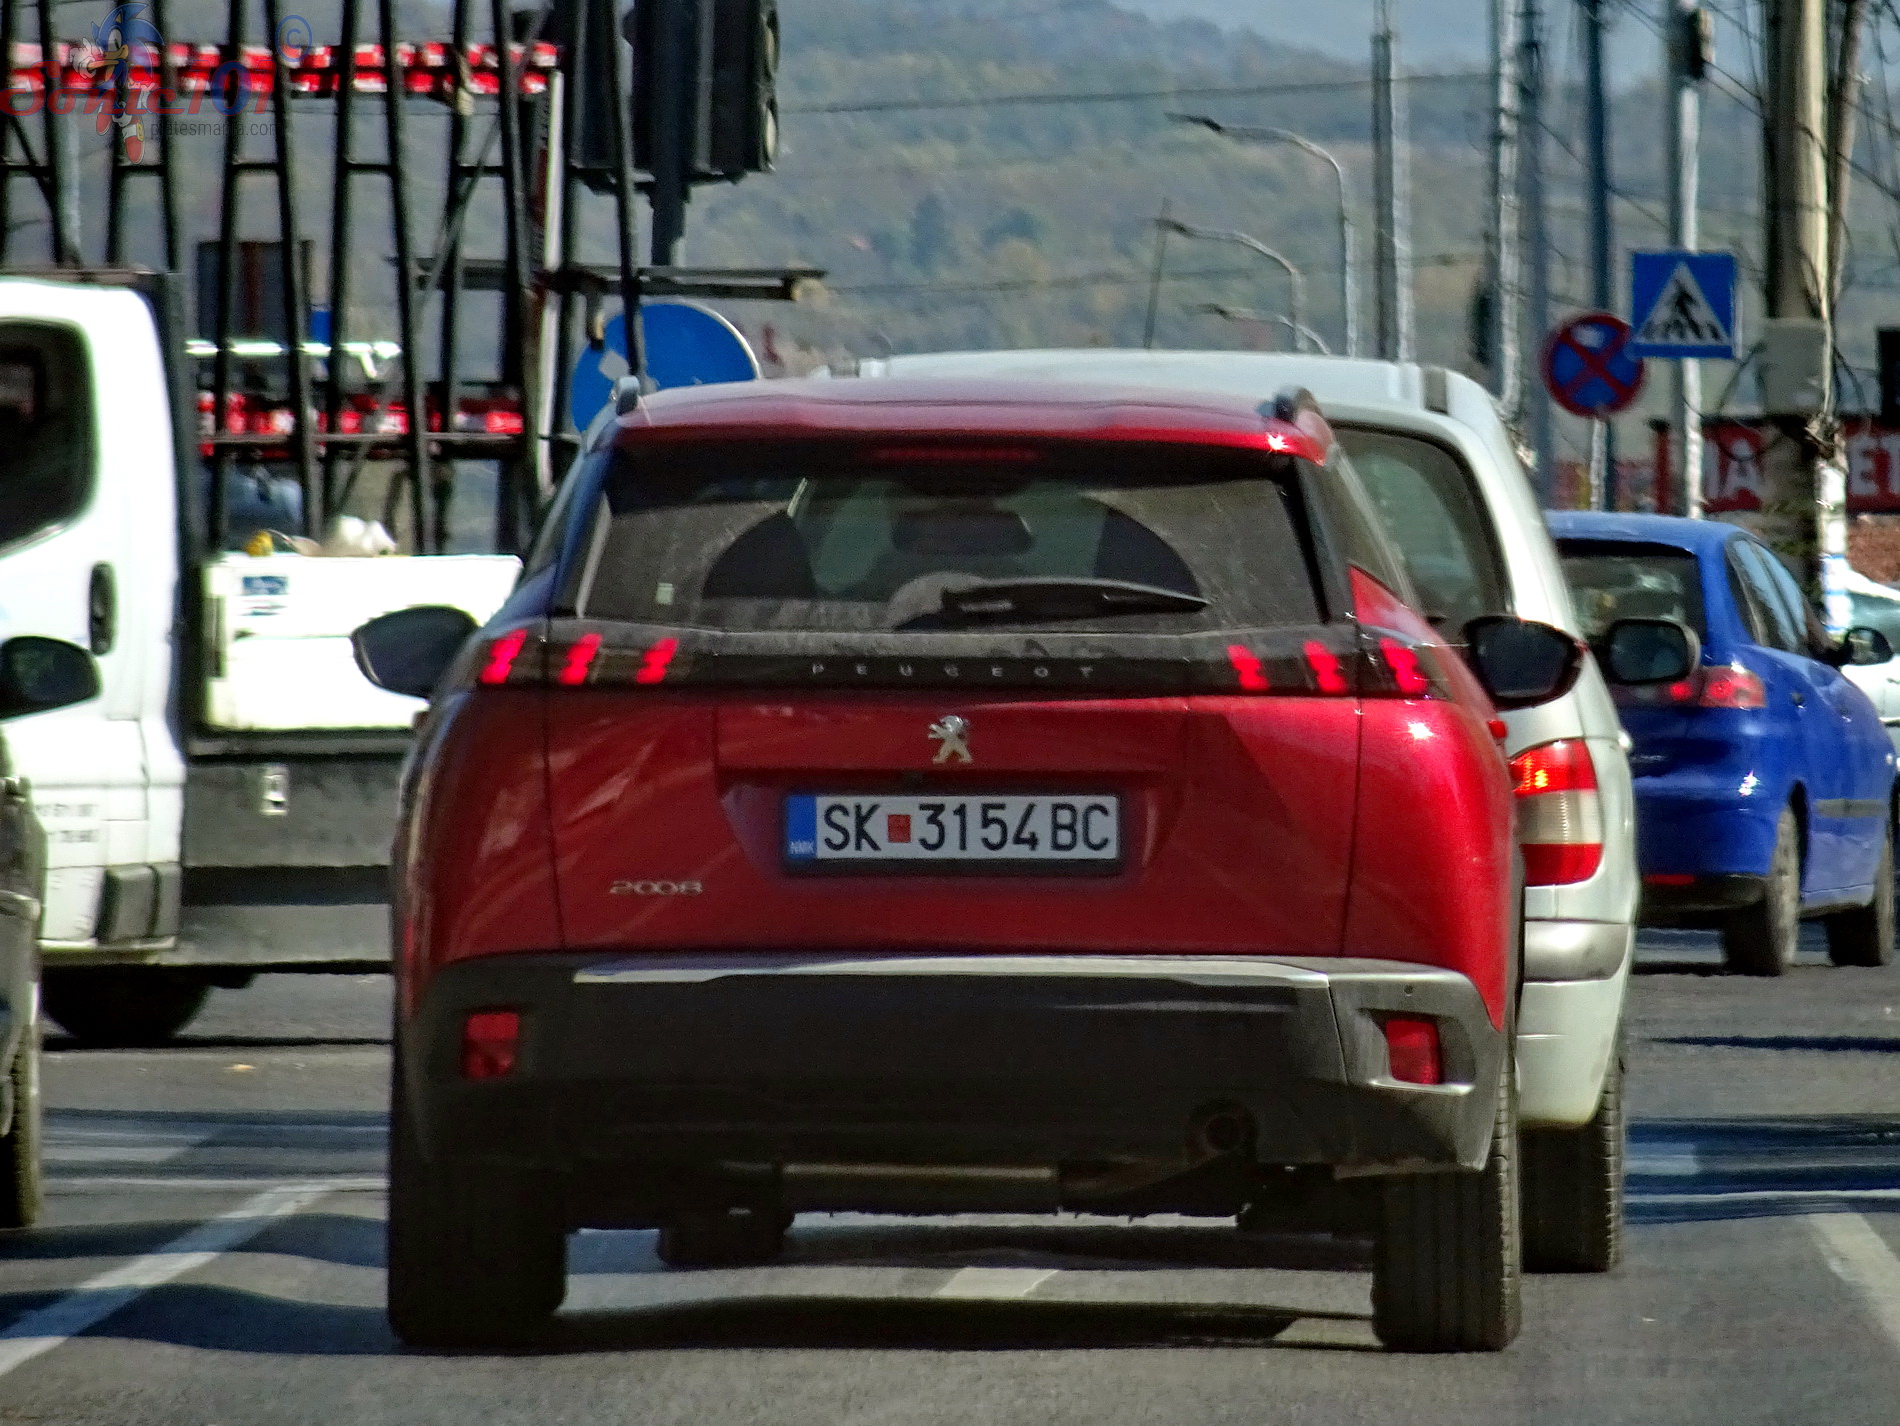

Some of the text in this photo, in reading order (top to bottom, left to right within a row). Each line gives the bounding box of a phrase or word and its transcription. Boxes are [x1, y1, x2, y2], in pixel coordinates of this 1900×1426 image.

[811, 663, 1093, 678] PEUGEOT
[823, 803, 882, 852] SK
[609, 880, 703, 896] 2008
